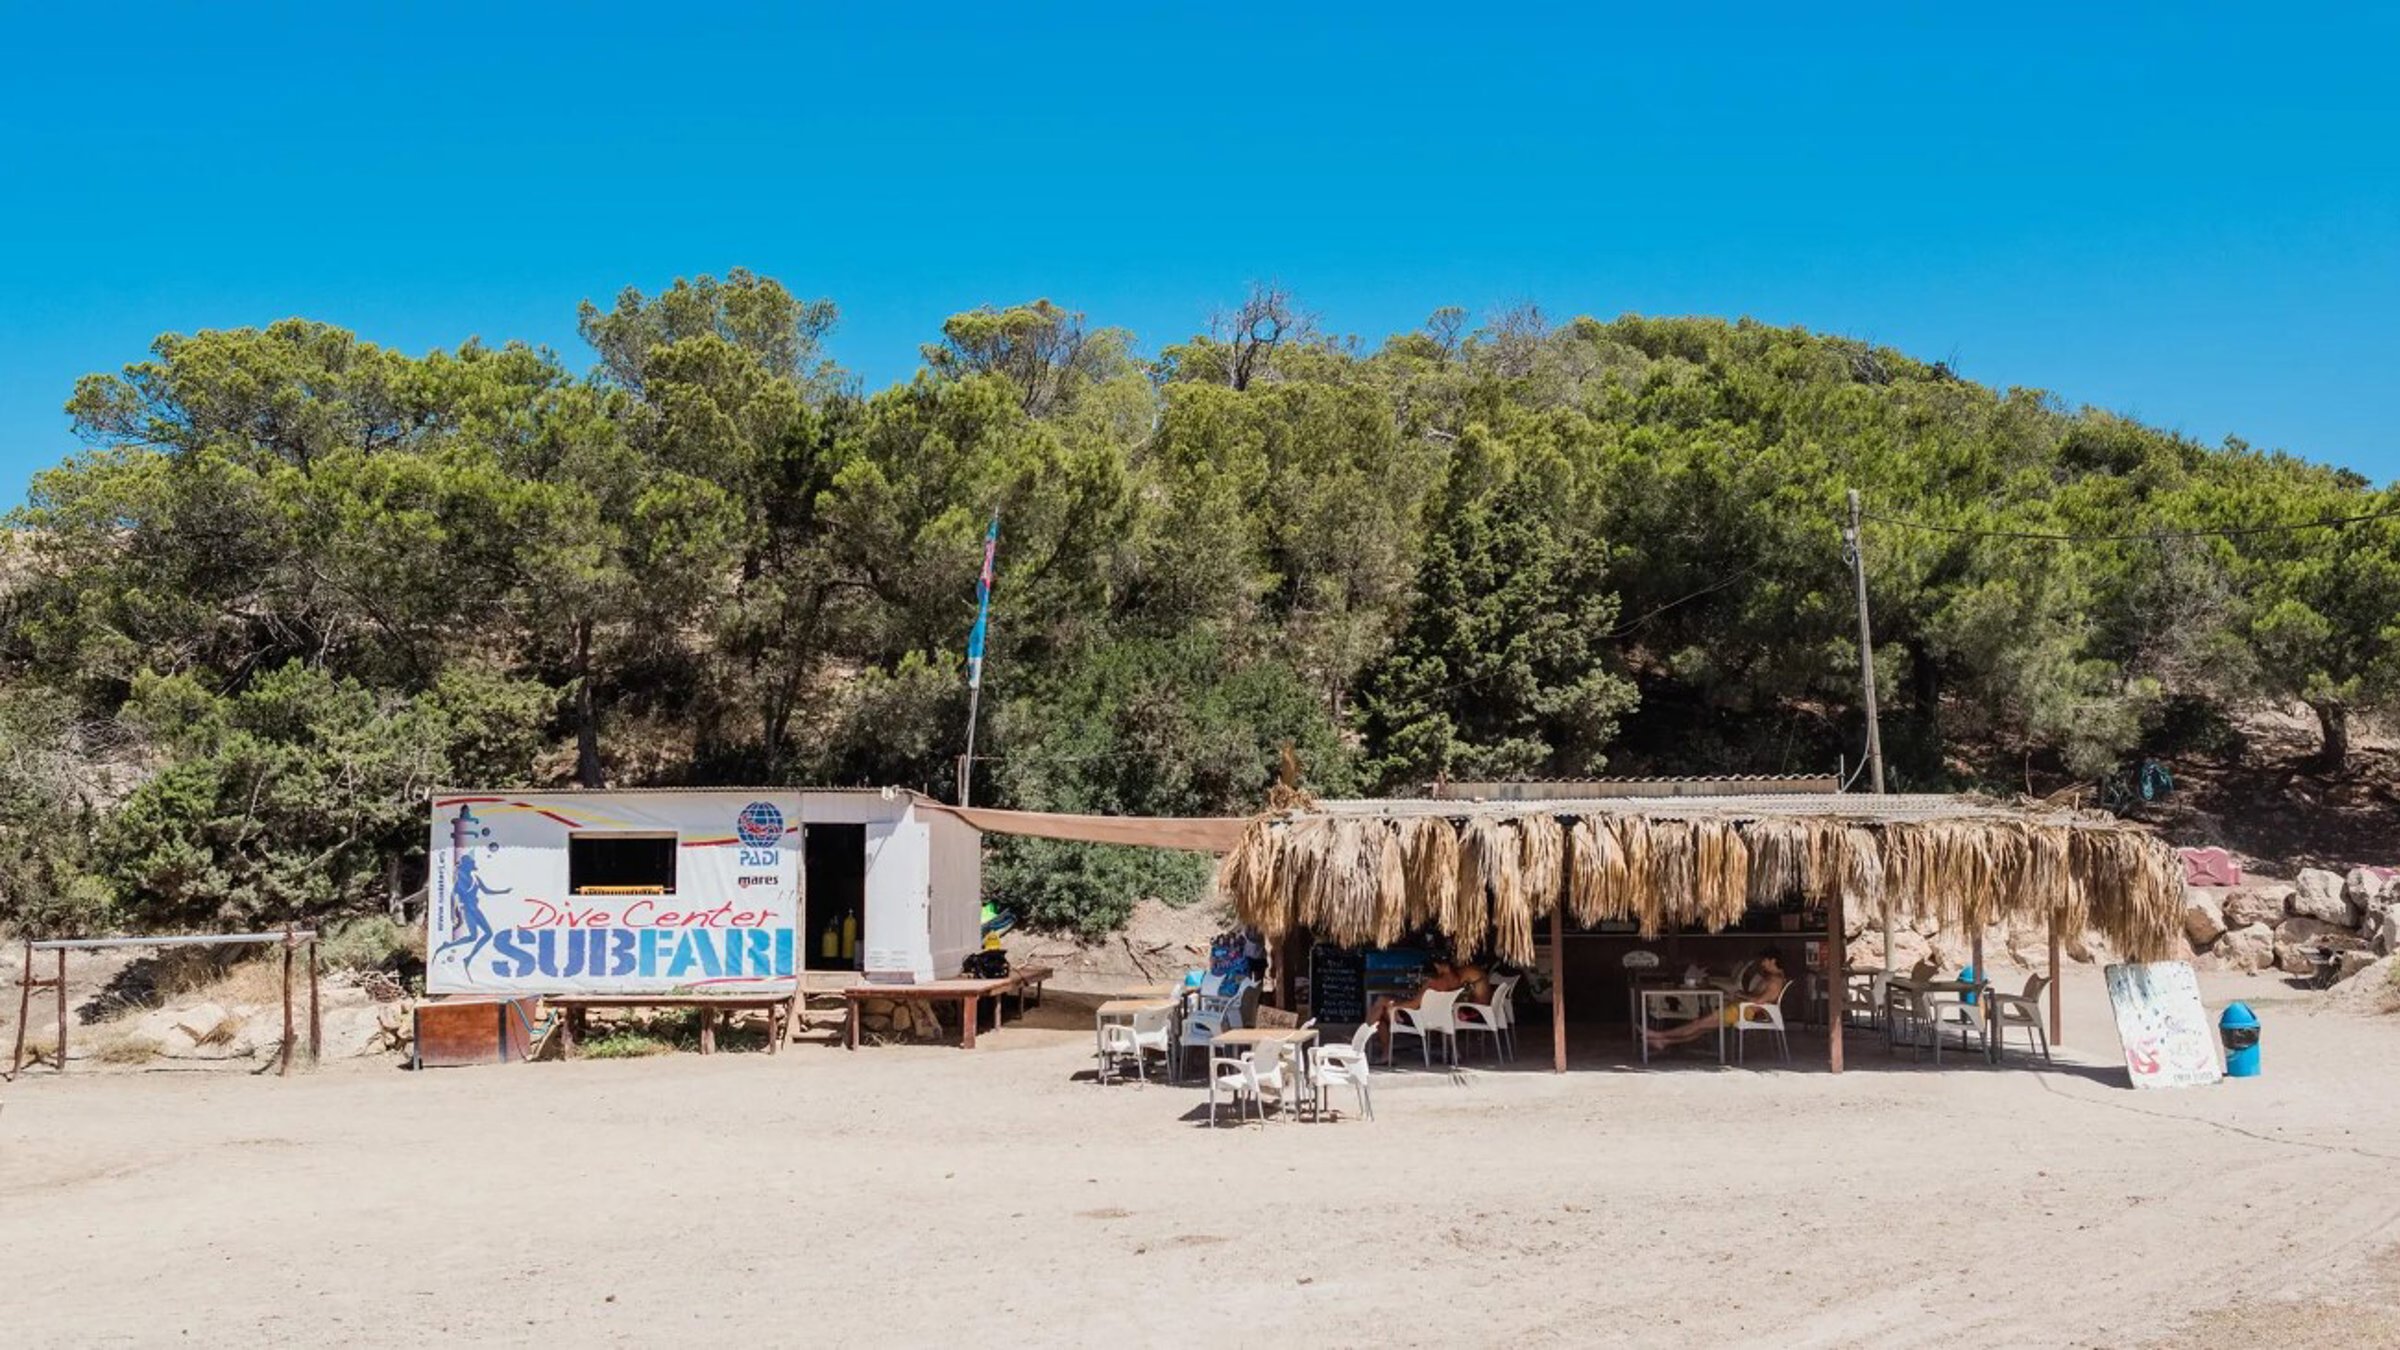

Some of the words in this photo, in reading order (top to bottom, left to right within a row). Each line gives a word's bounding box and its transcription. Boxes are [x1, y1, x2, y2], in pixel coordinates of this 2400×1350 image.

[739, 850, 779, 866] PADI
[737, 873, 779, 887] mares
[518, 898, 610, 930] Dive
[622, 900, 779, 928] Center
[492, 928, 794, 978] SUBFARI
